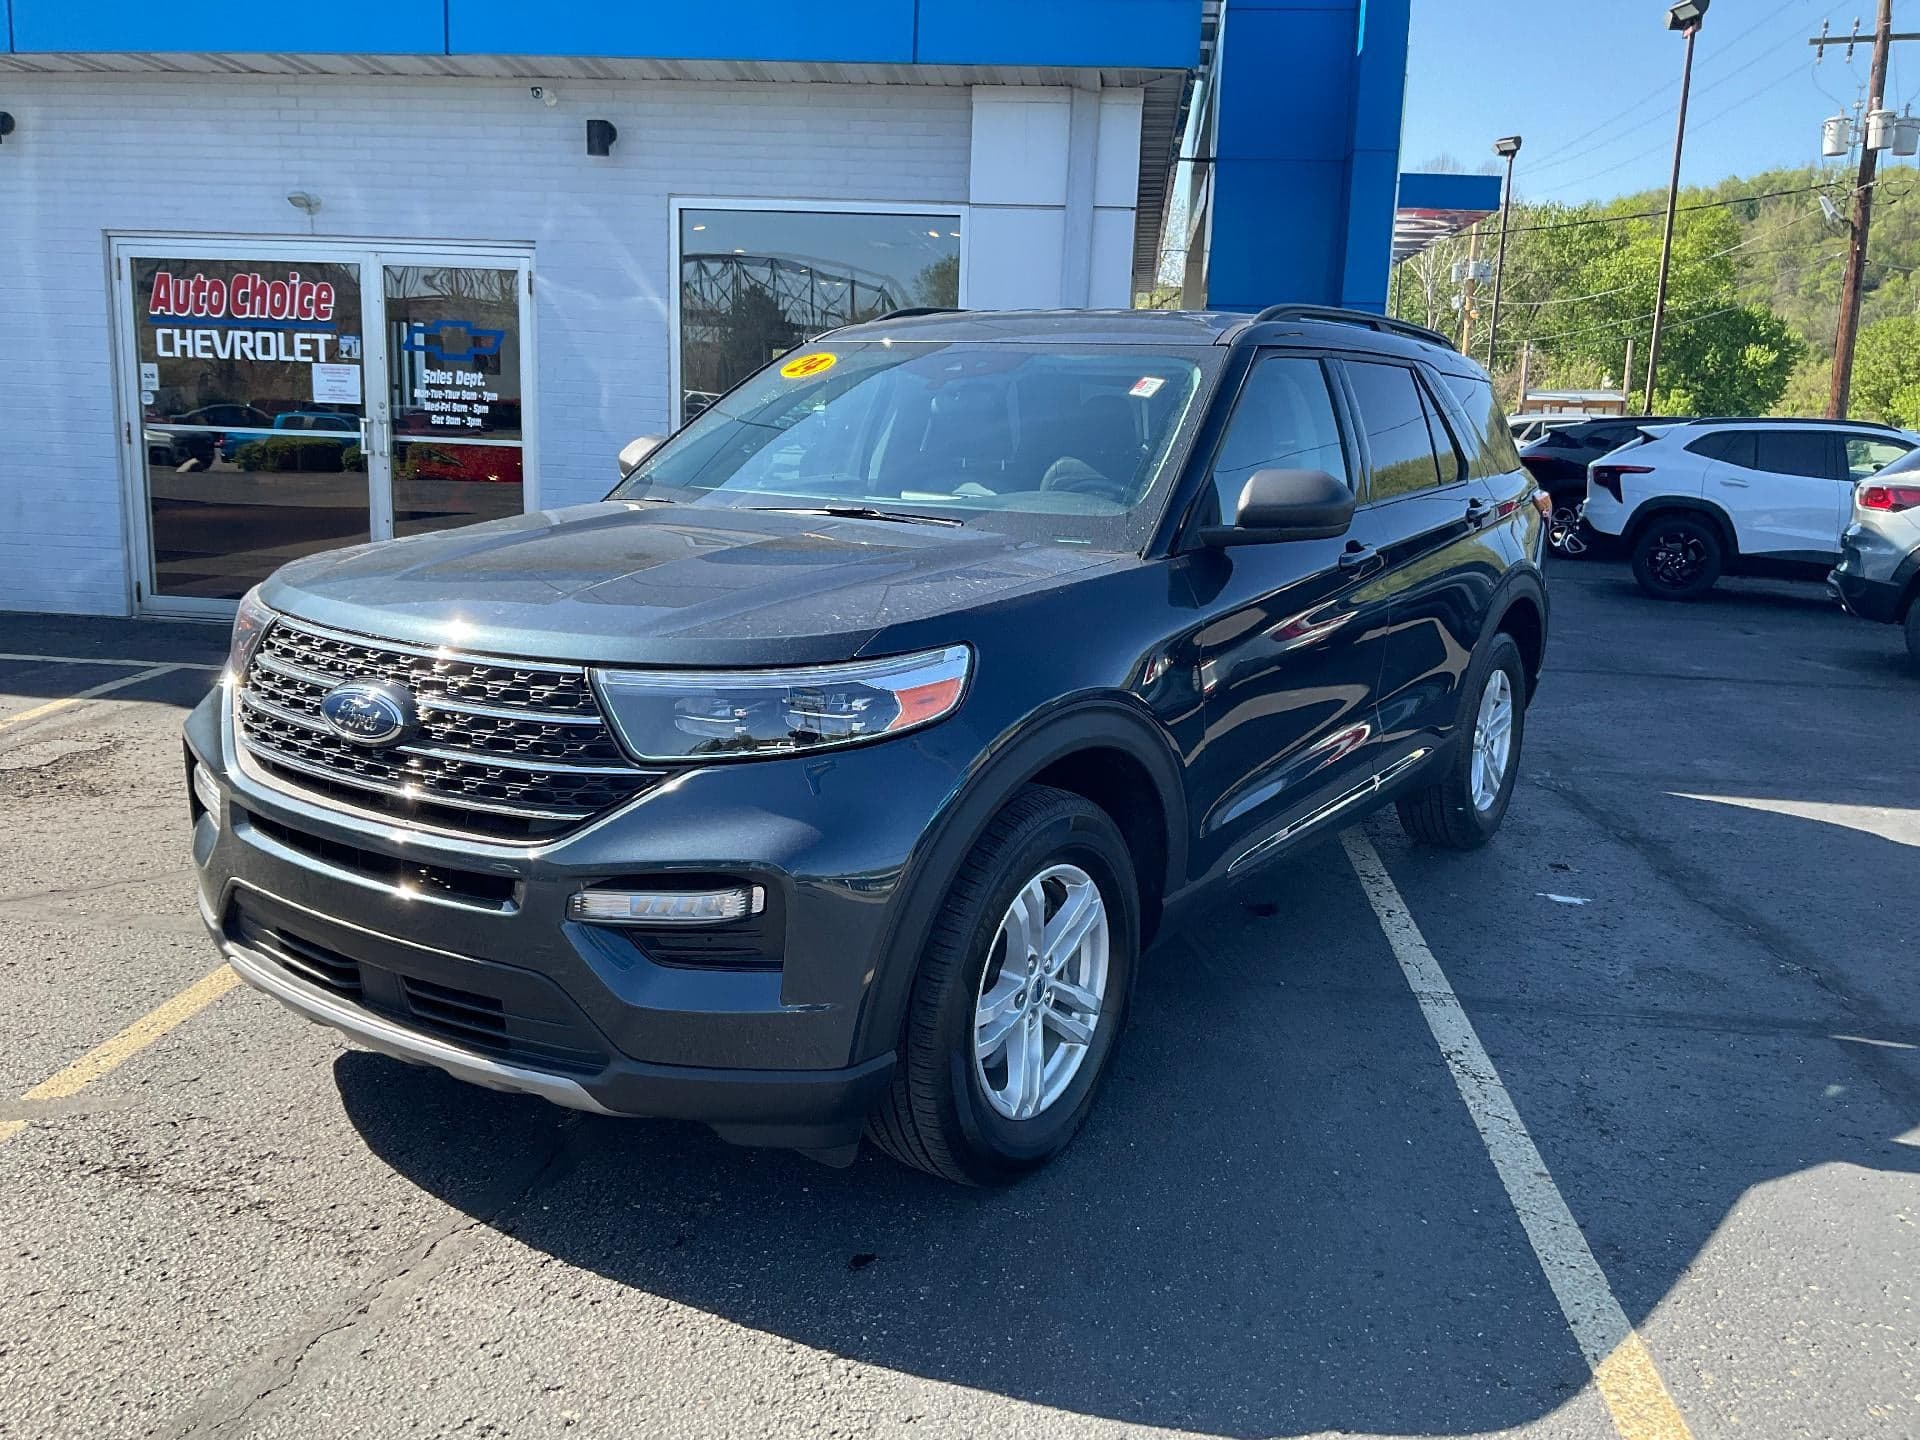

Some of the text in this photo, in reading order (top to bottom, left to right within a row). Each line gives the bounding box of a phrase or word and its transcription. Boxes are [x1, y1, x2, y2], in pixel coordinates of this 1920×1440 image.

[149, 271, 335, 322] Auto Choice
[156, 328, 337, 362] CHEVROLET
[422, 368, 486, 388] Sales Dept.
[461, 390, 477, 401] 9am
[482, 391, 498, 403] 7pm
[452, 402, 468, 413] 9am
[473, 403, 489, 415] 5pm
[431, 414, 444, 425] Sat
[445, 415, 461, 425] 9am
[335, 697, 381, 731] Ford
